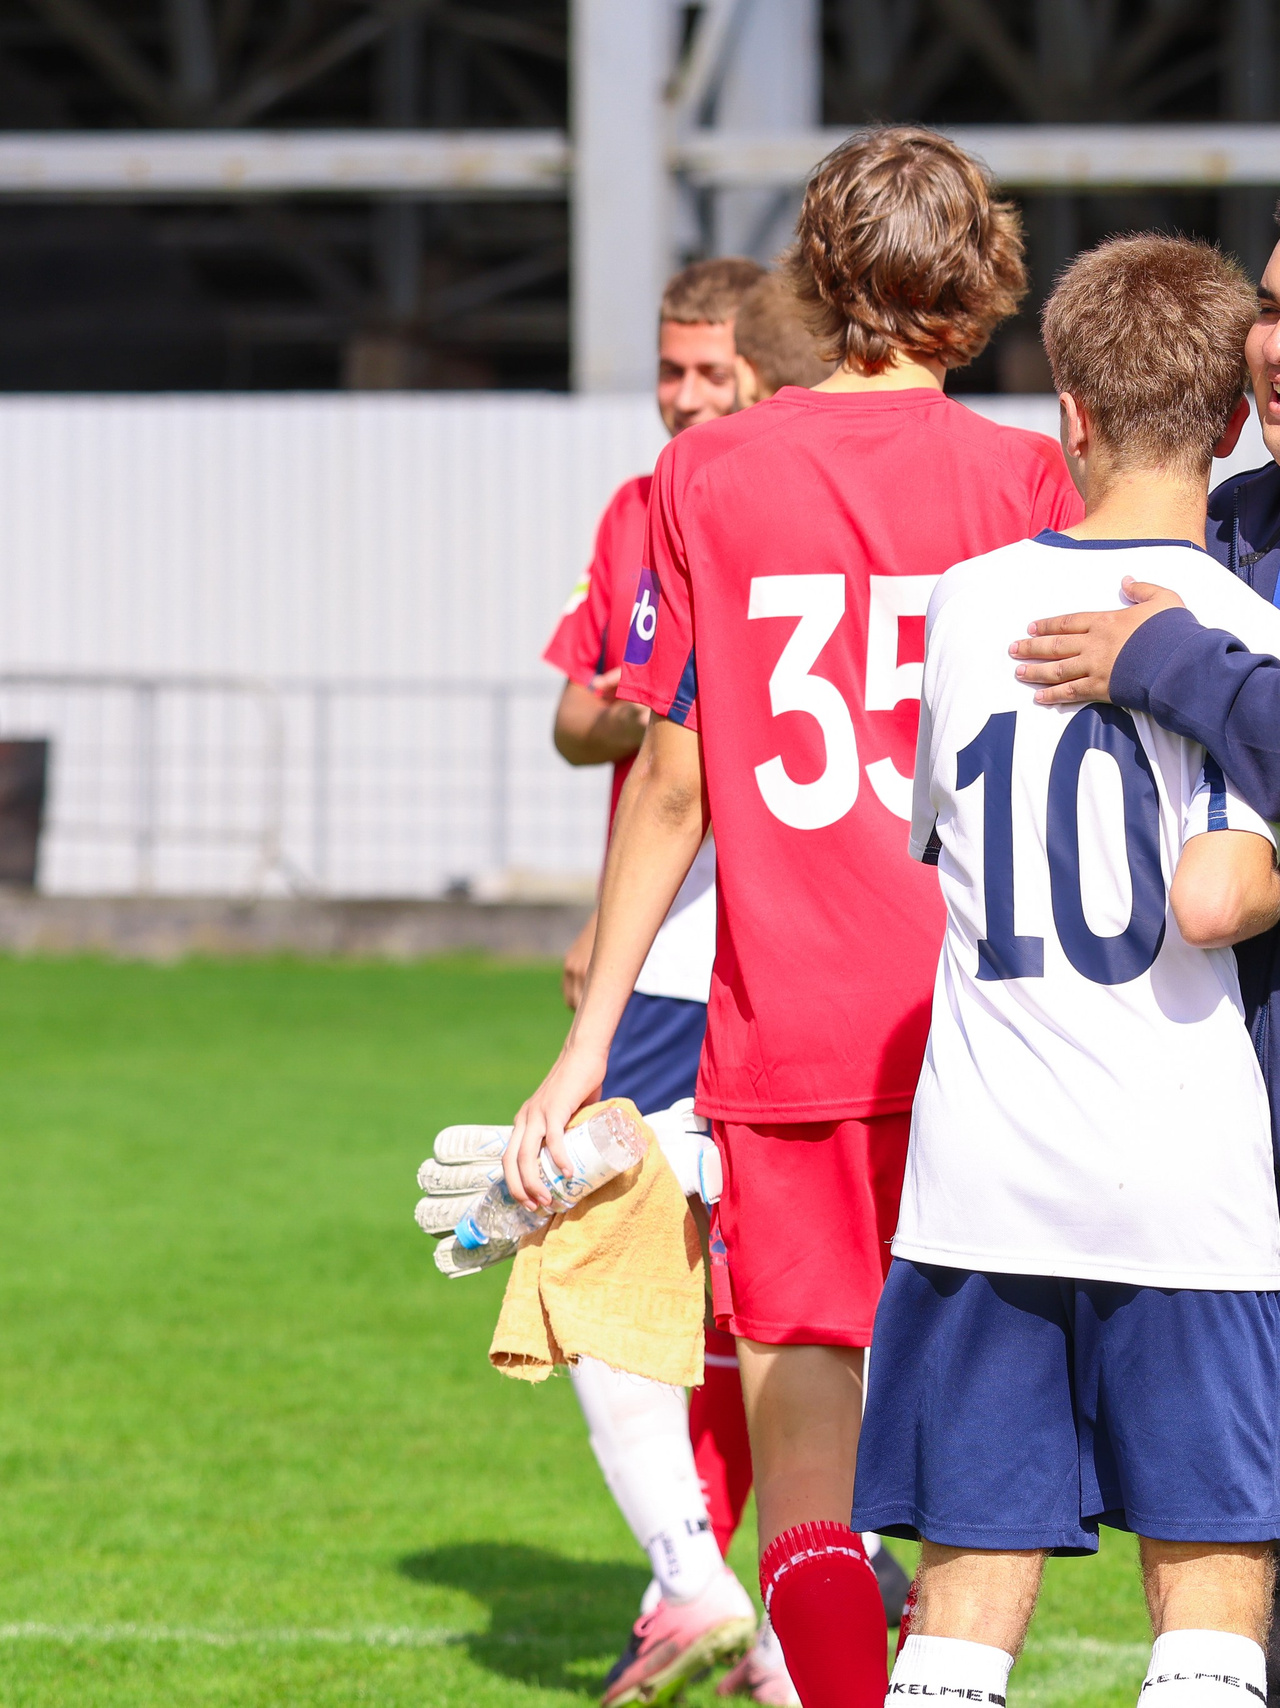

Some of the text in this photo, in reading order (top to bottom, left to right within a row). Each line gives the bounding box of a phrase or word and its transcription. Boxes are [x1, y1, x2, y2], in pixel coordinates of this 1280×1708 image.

[955, 702, 1166, 986] 10
[773, 1545, 862, 1583] KELME
[892, 1682, 984, 1702] KELME
